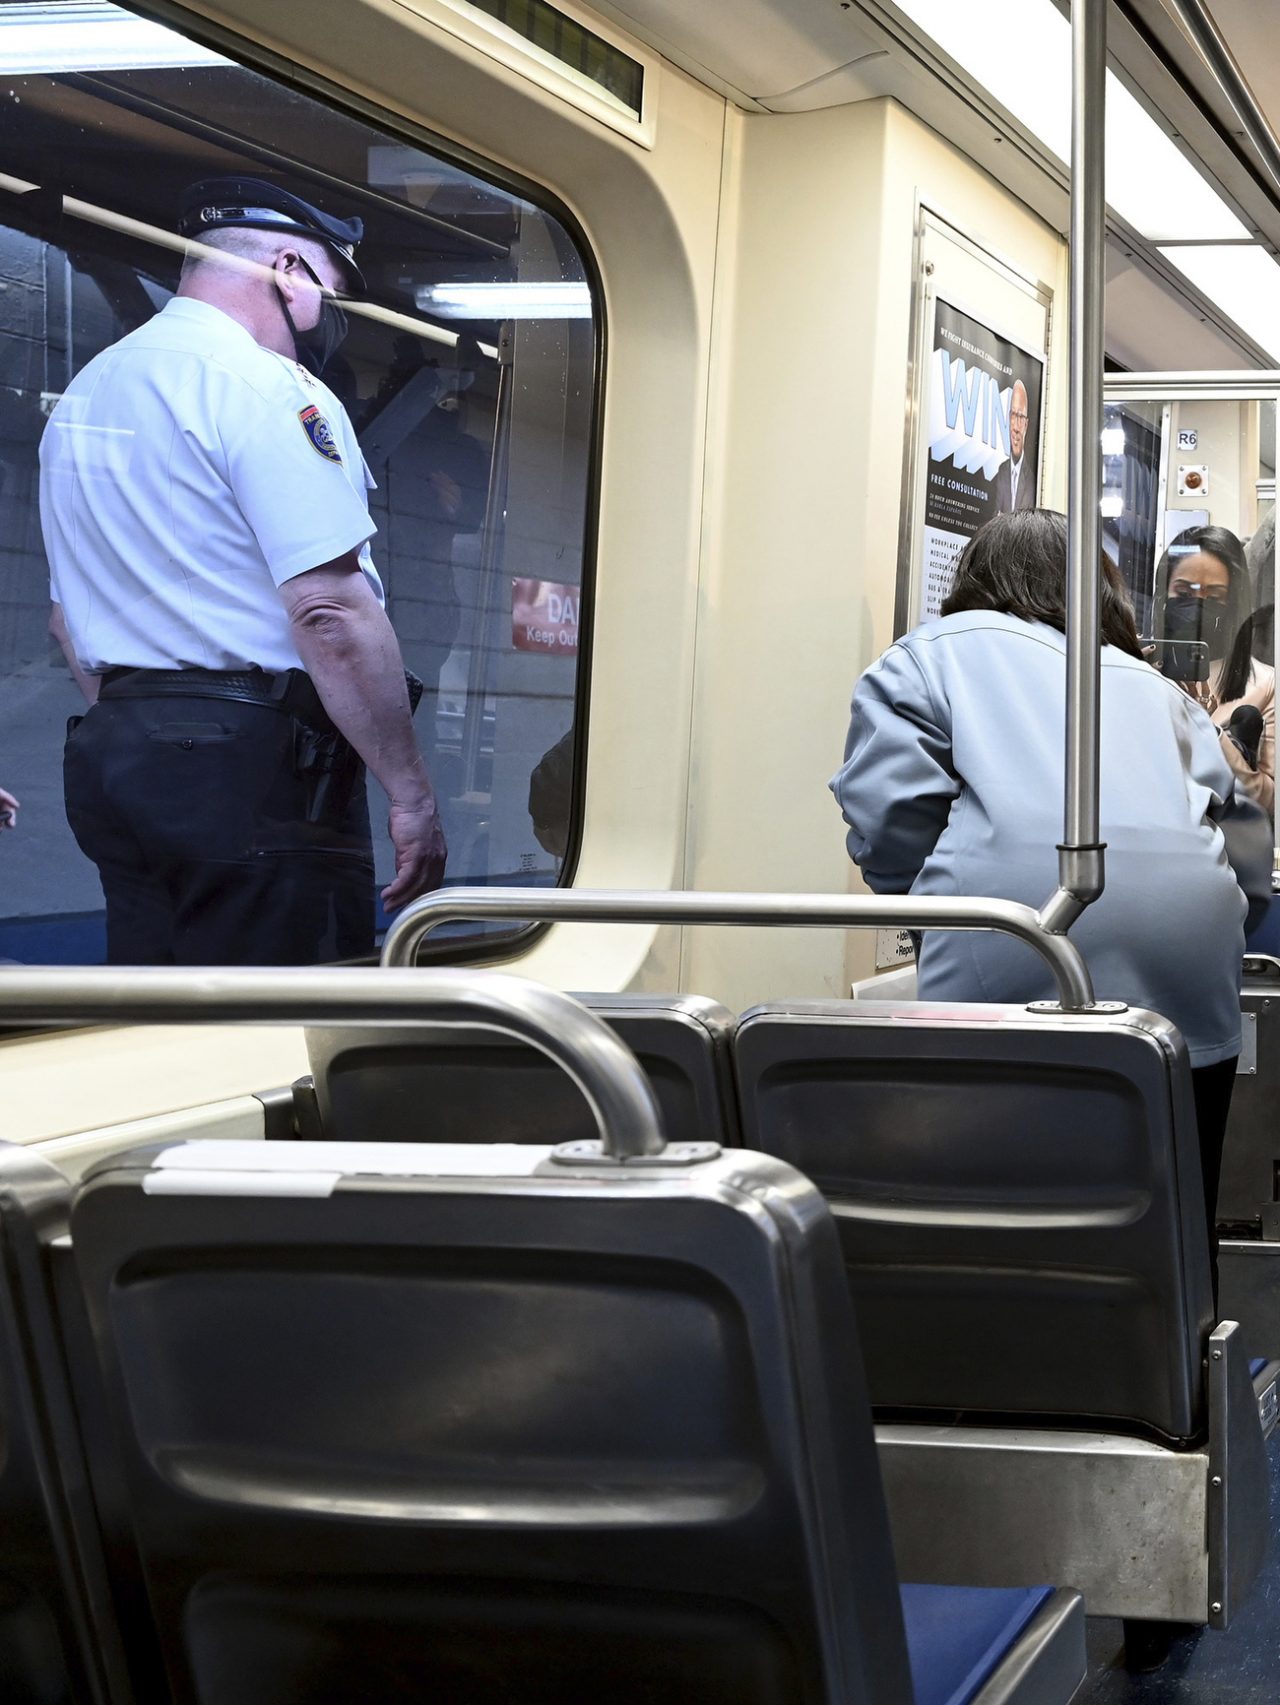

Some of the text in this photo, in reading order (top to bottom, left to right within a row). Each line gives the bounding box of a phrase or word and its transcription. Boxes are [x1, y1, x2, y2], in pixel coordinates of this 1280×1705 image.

[940, 348, 1012, 458] WIN
[1179, 433, 1197, 444] R6
[930, 473, 989, 501] FREE CONSULTATION
[930, 549, 949, 560] MEDICAL
[931, 537, 958, 550] WORKPLACE
[549, 593, 579, 626] DA
[526, 625, 555, 648] Keep
